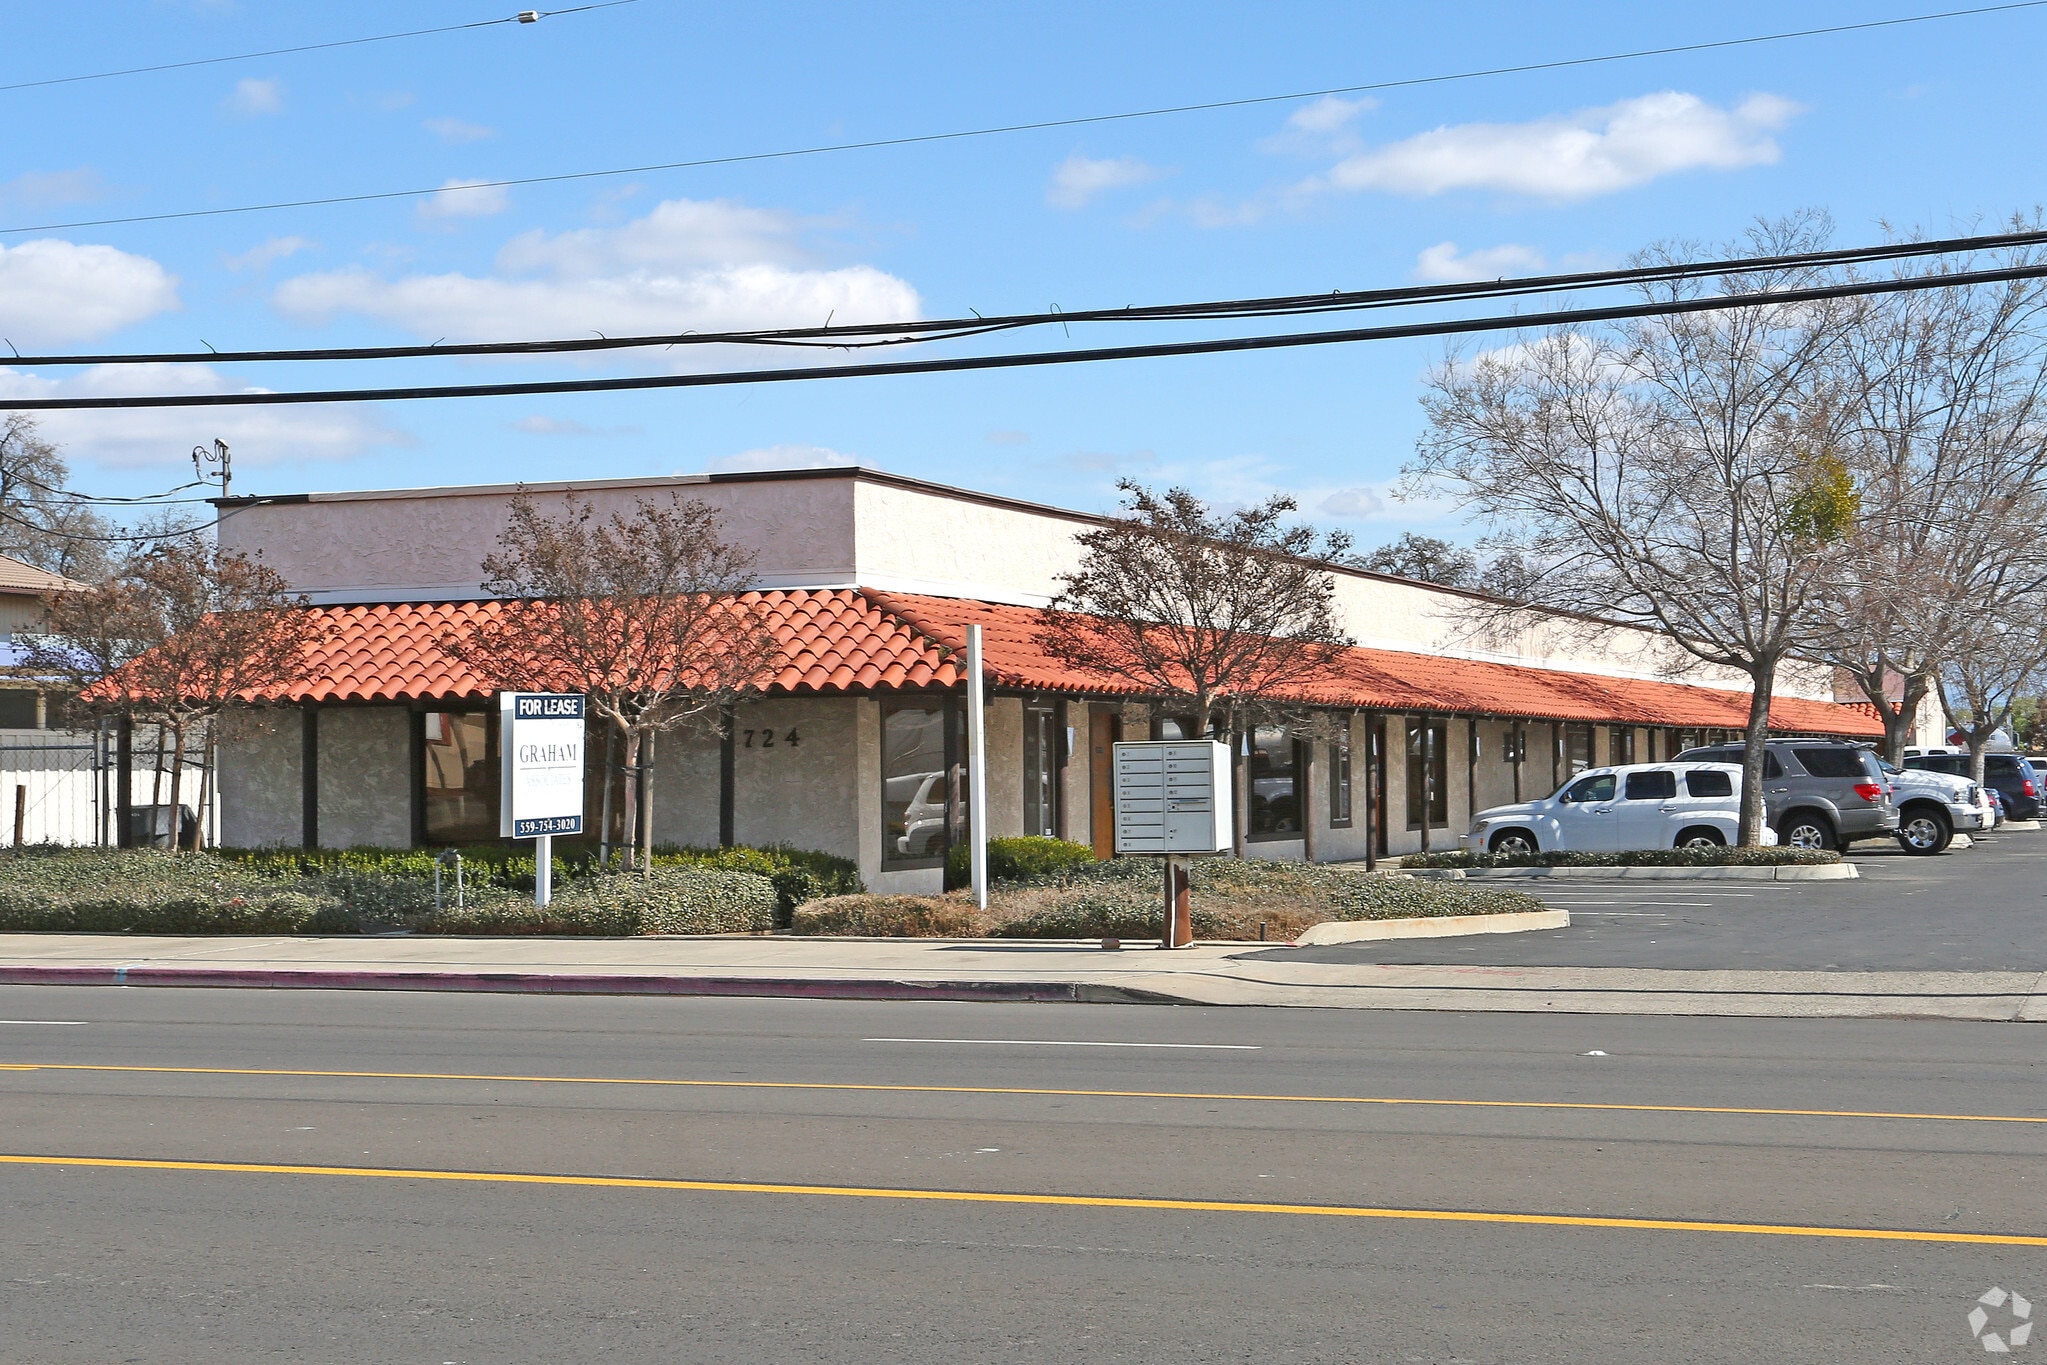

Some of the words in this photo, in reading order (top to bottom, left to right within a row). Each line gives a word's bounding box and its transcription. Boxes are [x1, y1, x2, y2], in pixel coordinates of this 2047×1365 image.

[519, 699, 541, 716] FOR
[544, 699, 579, 715] LEASE
[743, 727, 801, 748] 724
[519, 744, 577, 763] GRAHAM
[519, 818, 576, 834] 559-754-3020
